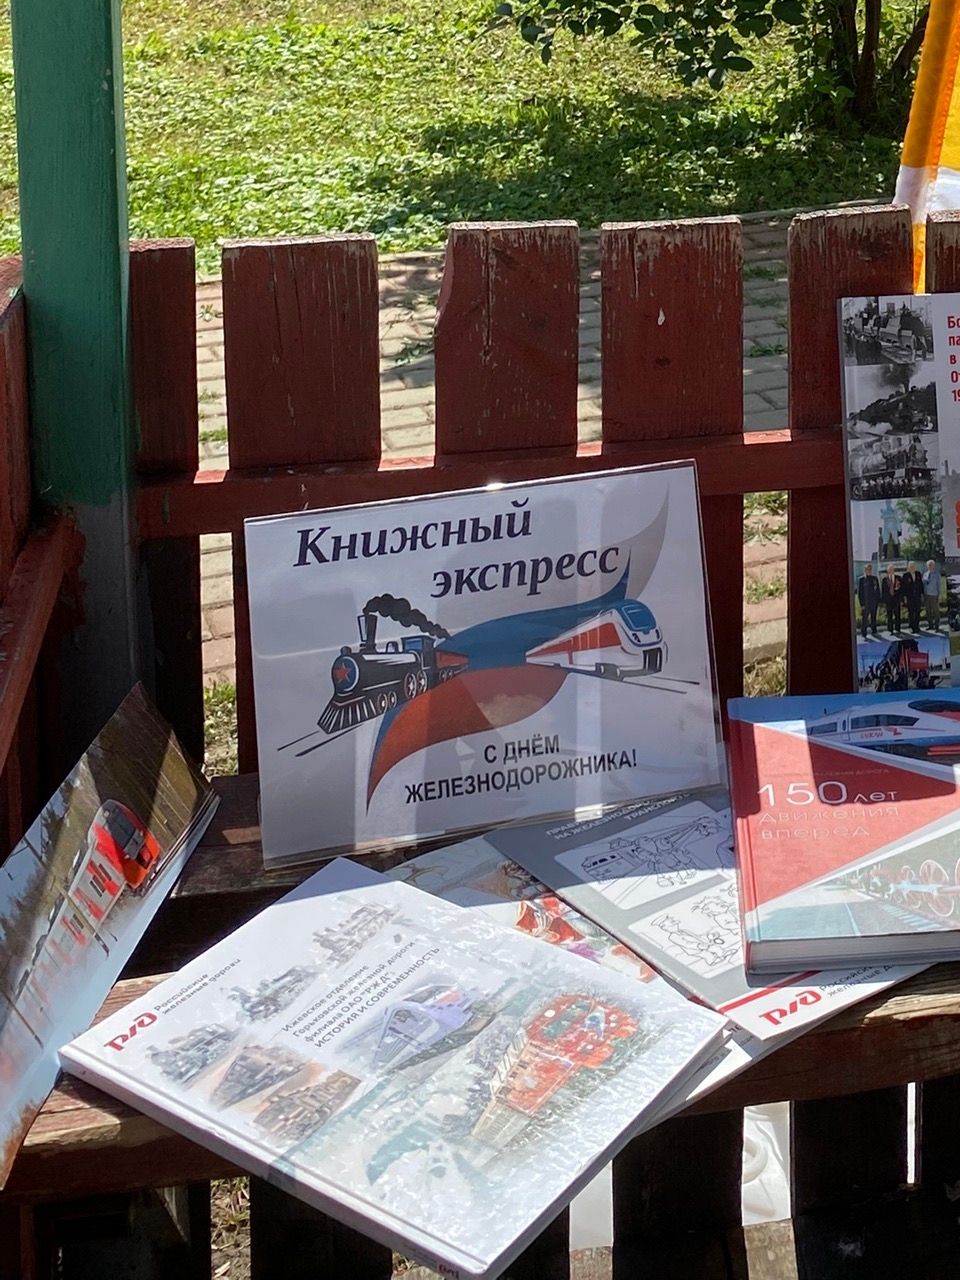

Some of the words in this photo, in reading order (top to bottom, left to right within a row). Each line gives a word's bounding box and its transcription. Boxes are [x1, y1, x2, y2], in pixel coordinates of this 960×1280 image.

[950, 355, 957, 365] в
[292, 497, 532, 567] Книжный
[430, 546, 619, 598] экспресс
[483, 743, 497, 763] С
[503, 734, 560, 764] ДНЁМ
[405, 748, 637, 804] ЖЕЛЕЗНОДОРОЖНИКА!
[757, 780, 849, 808] 150
[153, 973, 210, 1012] Российские
[161, 980, 209, 1016] железные
[206, 957, 242, 986] дороги
[280, 997, 328, 1033] Ижевское
[323, 964, 370, 1000] отделение
[362, 945, 444, 1008] СОВРЕМЕННОСТЬ
[290, 992, 350, 1038] Горьковской
[302, 1010, 346, 1044] филиала
[340, 994, 363, 1015] ОАО
[312, 1010, 361, 1049] ИСТОРИЯ
[357, 1003, 368, 1013] И
